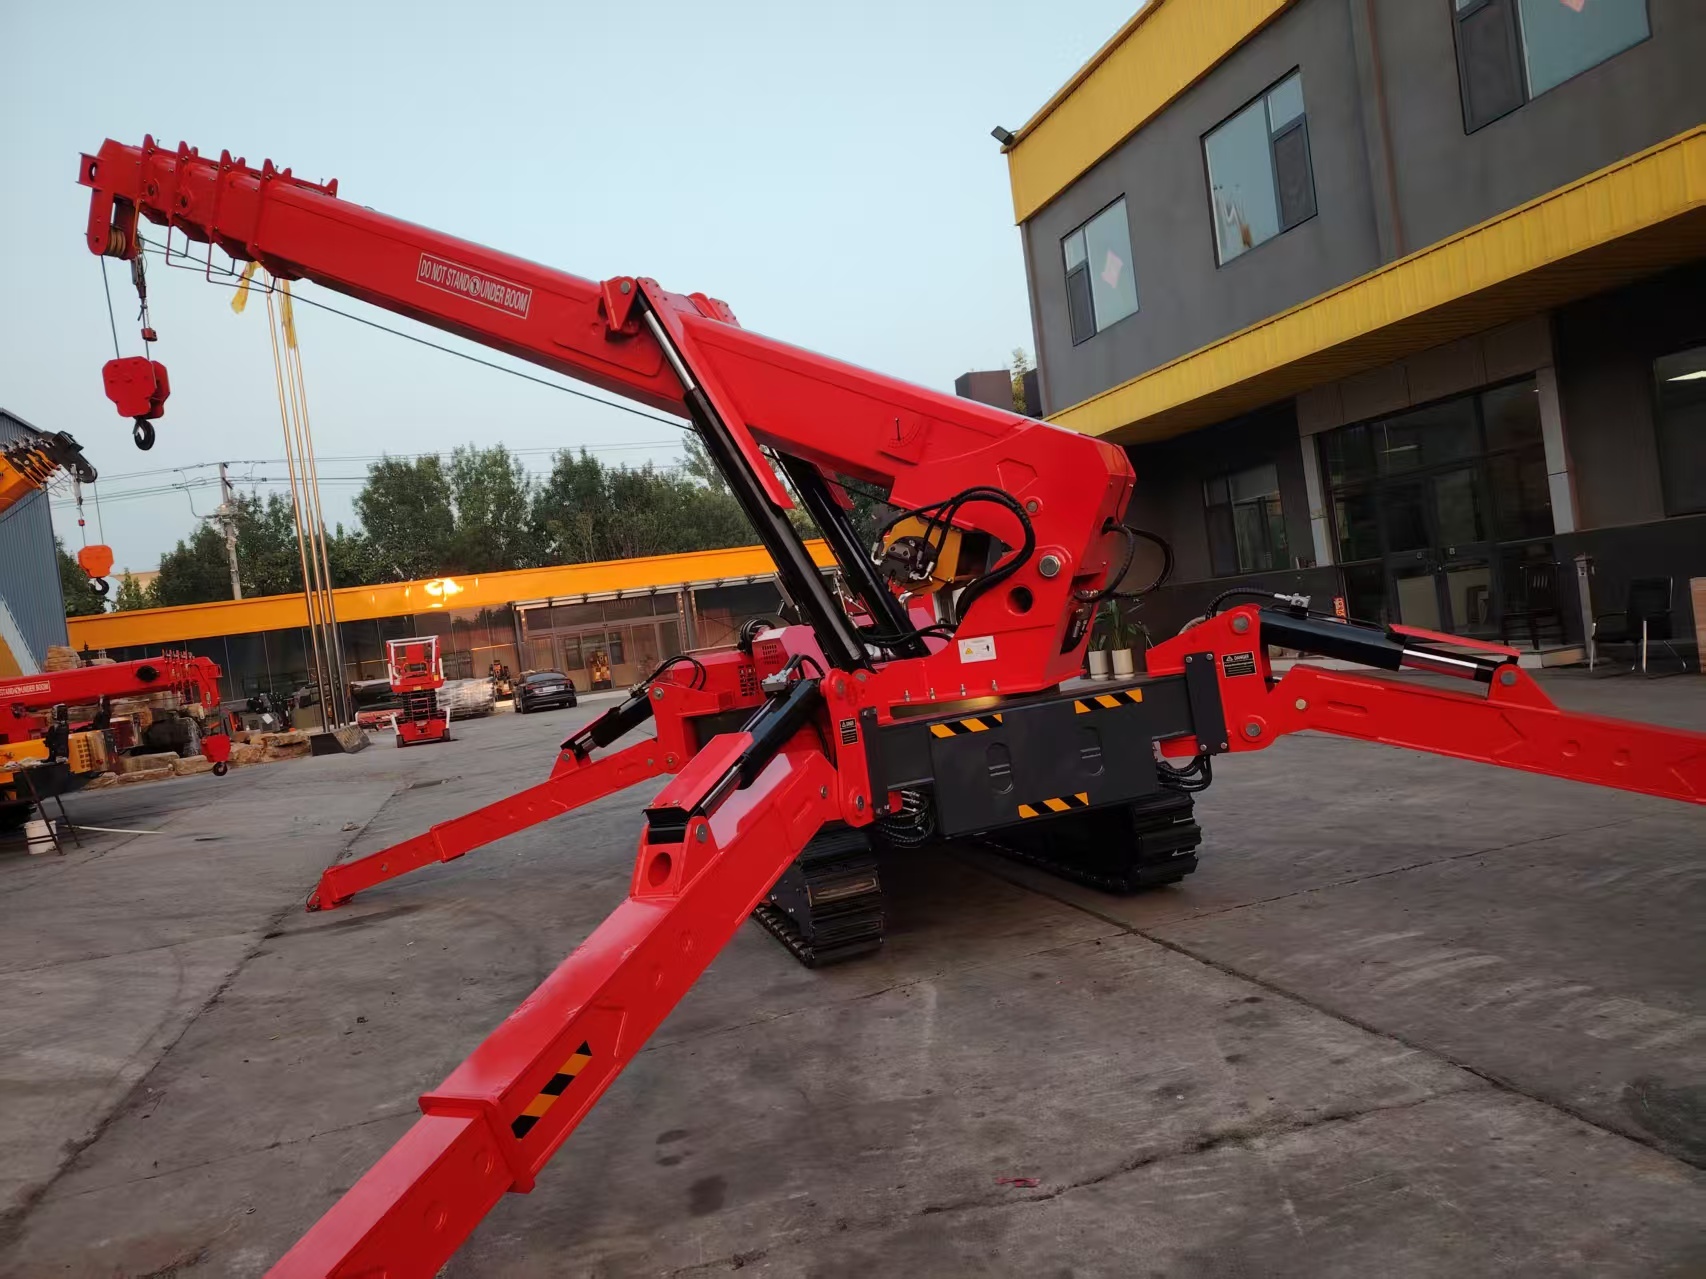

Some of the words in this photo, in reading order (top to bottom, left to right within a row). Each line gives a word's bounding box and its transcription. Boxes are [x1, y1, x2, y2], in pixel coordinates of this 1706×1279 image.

[420, 259, 432, 278] DO
[431, 263, 447, 284] NOT
[445, 268, 471, 292] STAND
[480, 279, 505, 305] UNDER
[504, 288, 528, 312] BOOM
